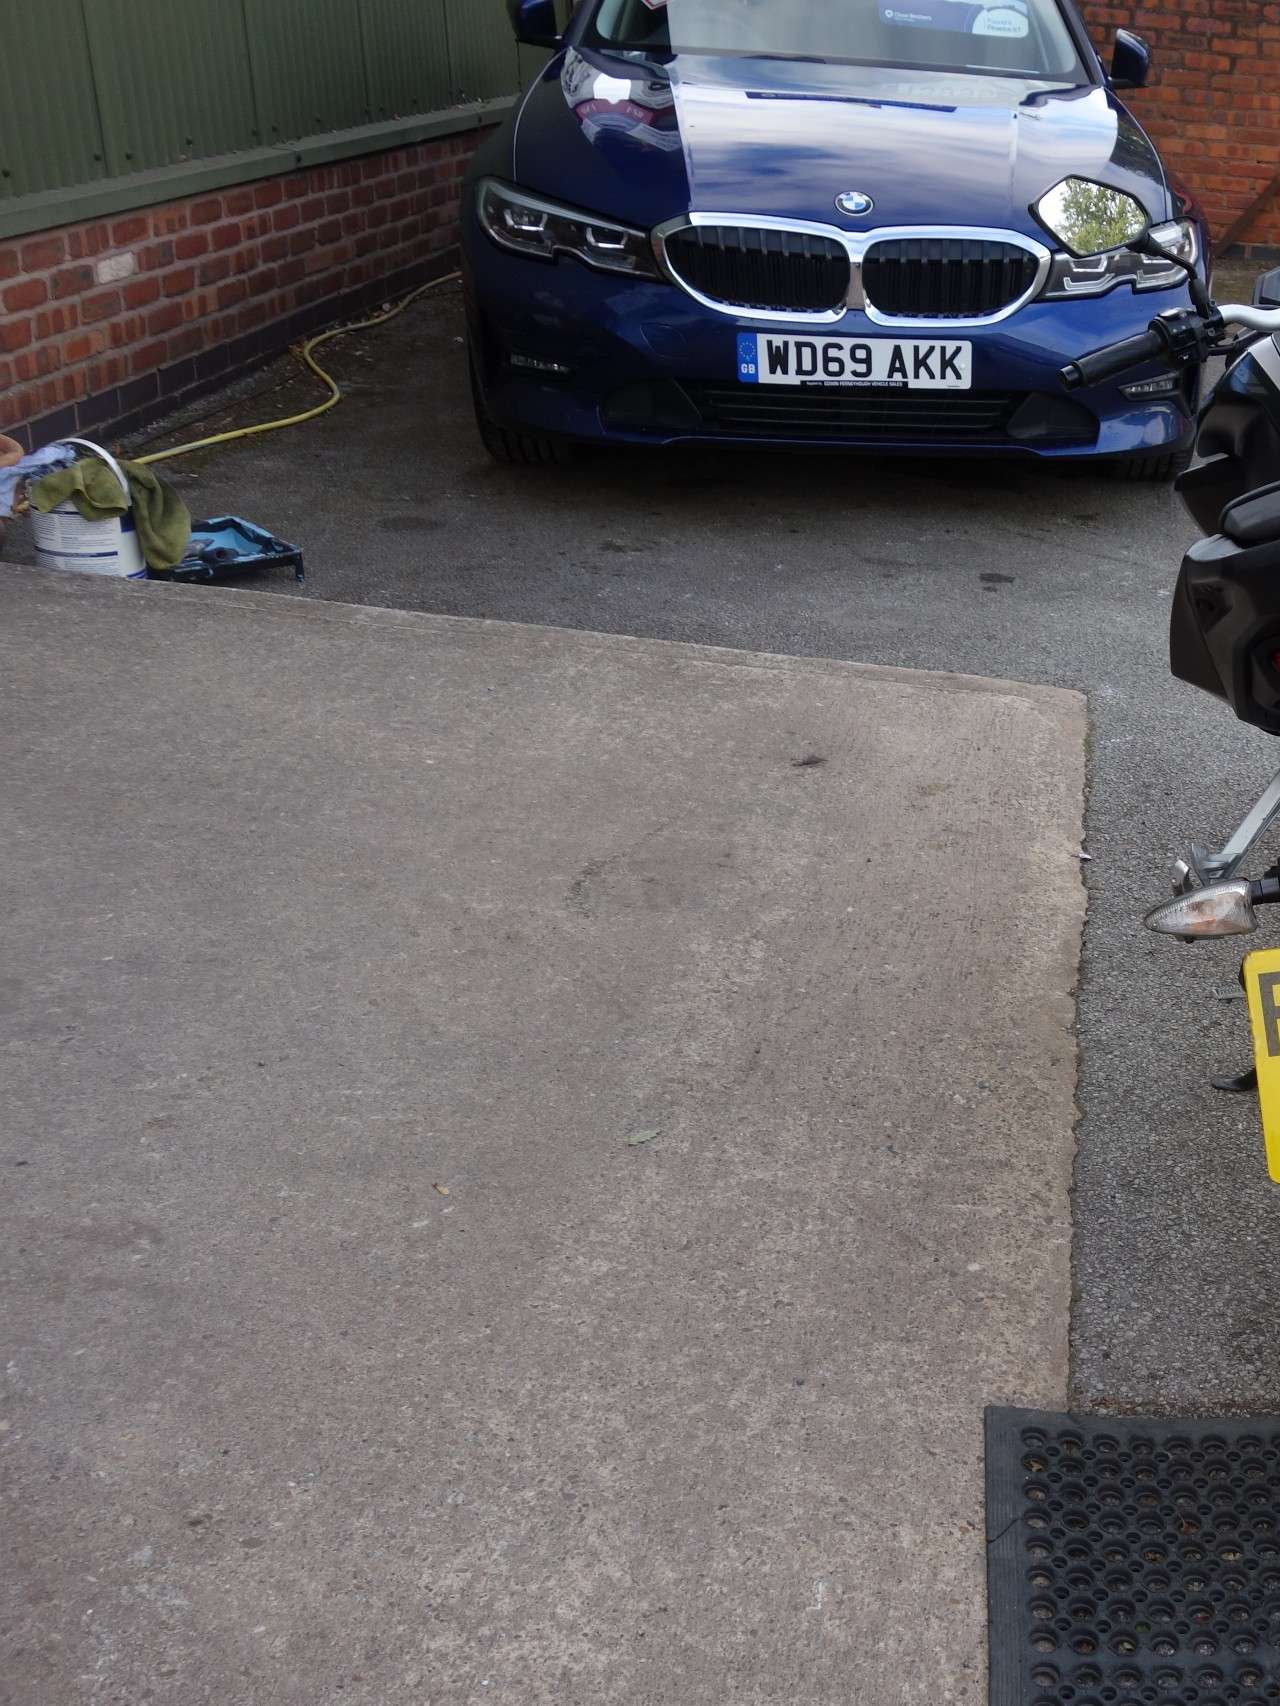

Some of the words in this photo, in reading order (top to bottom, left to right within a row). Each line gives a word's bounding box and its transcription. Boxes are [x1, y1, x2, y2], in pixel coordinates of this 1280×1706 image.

[740, 363, 756, 374] GB
[766, 339, 873, 378] WD69
[887, 344, 963, 380] AKK
